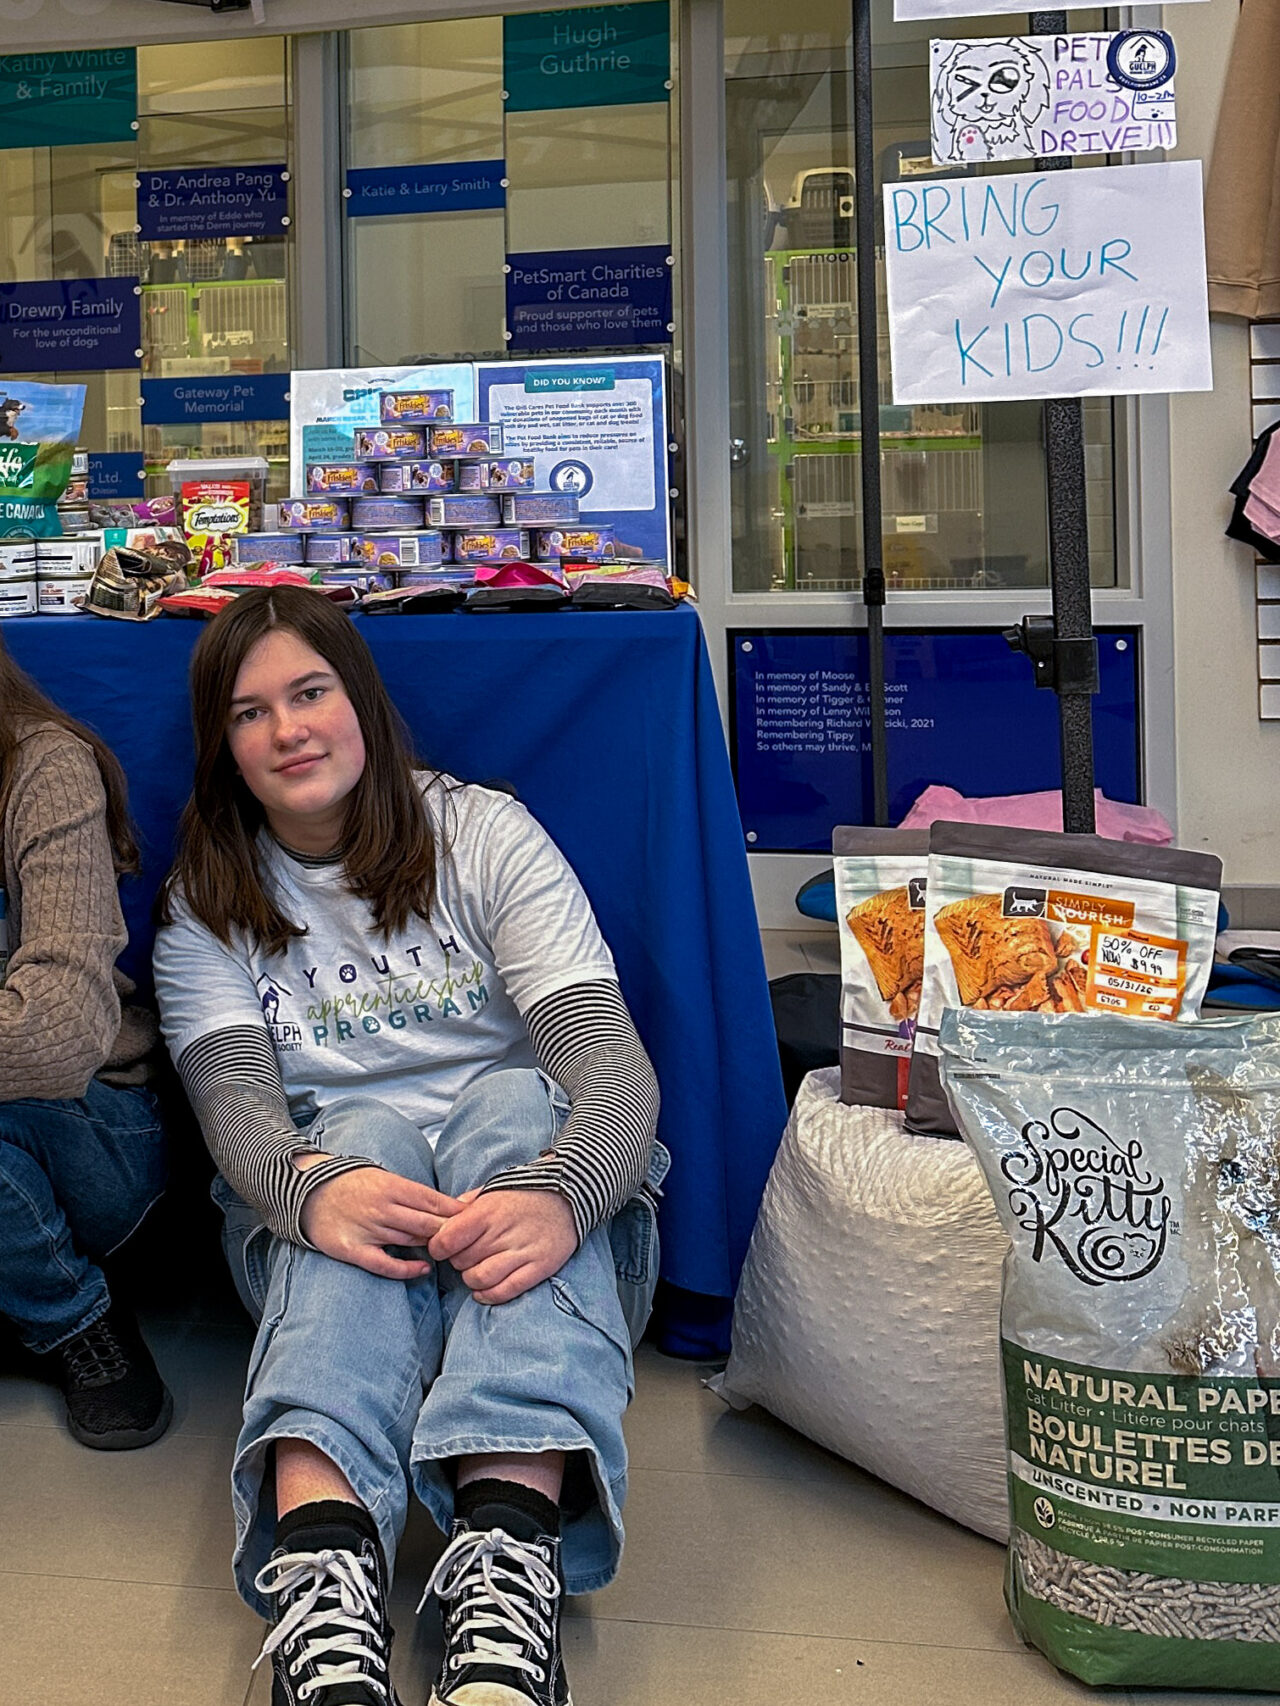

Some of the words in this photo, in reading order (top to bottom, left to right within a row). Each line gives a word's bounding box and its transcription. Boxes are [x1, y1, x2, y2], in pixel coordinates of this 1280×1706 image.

[553, 23, 617, 48] Hugh
[63, 49, 126, 68] White
[540, 51, 631, 75] Guthrie
[16, 82, 32, 99] &
[40, 75, 109, 100] Family
[1054, 99, 1129, 124] FOOD
[1040, 122, 1172, 154] DRIVE!!!
[151, 176, 171, 191] Dr.
[176, 174, 230, 190] Andrea
[236, 172, 273, 189] Pang
[362, 184, 395, 197] Katie
[400, 184, 410, 195] &
[414, 181, 447, 196] Larry
[452, 179, 490, 192] Smith
[148, 194, 159, 207] &
[164, 192, 186, 206] Dr.
[190, 189, 253, 209] Anthony
[258, 189, 276, 202] Yu
[892, 178, 1059, 251] BRING
[513, 269, 586, 285] PetSmart
[592, 265, 663, 281] Charities
[974, 238, 1138, 308] YOUR
[547, 286, 563, 300] of
[568, 284, 629, 300] Canada
[10, 302, 66, 321] Drewry
[71, 300, 123, 319] Family
[519, 309, 553, 321] Proud
[556, 308, 615, 322] supporter
[617, 306, 630, 317] of
[633, 306, 658, 318] pets
[13, 328, 30, 338] For
[33, 328, 49, 338] the
[53, 324, 121, 337] unconditional
[516, 322, 538, 333] and
[540, 320, 572, 331] those
[575, 320, 601, 330] who
[603, 319, 629, 329] love
[631, 317, 662, 328] them
[35, 339, 58, 348] love
[60, 338, 71, 348] of
[73, 336, 98, 348] dogs
[956, 305, 1169, 385] KIDS!!!
[552, 378, 570, 386] YOU
[573, 376, 606, 385] KNOW?
[174, 387, 229, 402] Gateway
[233, 386, 255, 399] Pet
[185, 401, 245, 413] Memorial
[194, 511, 240, 529] Temptations
[755, 671, 764, 680] In
[767, 672, 807, 682] memory
[809, 671, 819, 680] of
[822, 671, 855, 680] Moose
[757, 719, 824, 729] Remembering
[826, 718, 862, 728] Richard
[757, 730, 824, 741] Remembering
[827, 730, 854, 741] Tippy
[1056, 897, 1106, 912] SIMPLY
[1103, 936, 1132, 954] 50%
[1140, 946, 1163, 960] OFF
[303, 935, 461, 988] YOUTH
[307, 951, 484, 1046] apprenticeship
[313, 984, 490, 1046] PROGRAM
[1001, 1107, 1152, 1197] Special
[1008, 1175, 1171, 1287] Kitty
[1023, 1360, 1187, 1412] NATURAL
[1026, 1388, 1046, 1406] Cat
[1050, 1397, 1092, 1418] Litter
[1112, 1409, 1166, 1428] Litière
[1172, 1416, 1212, 1432] pour
[1219, 1417, 1265, 1433] chats
[1027, 1407, 1231, 1465] BOULETTES
[1029, 1434, 1186, 1490] NATUREL
[1032, 1469, 1143, 1511] UNSCENTED
[1170, 1503, 1216, 1519] NON
